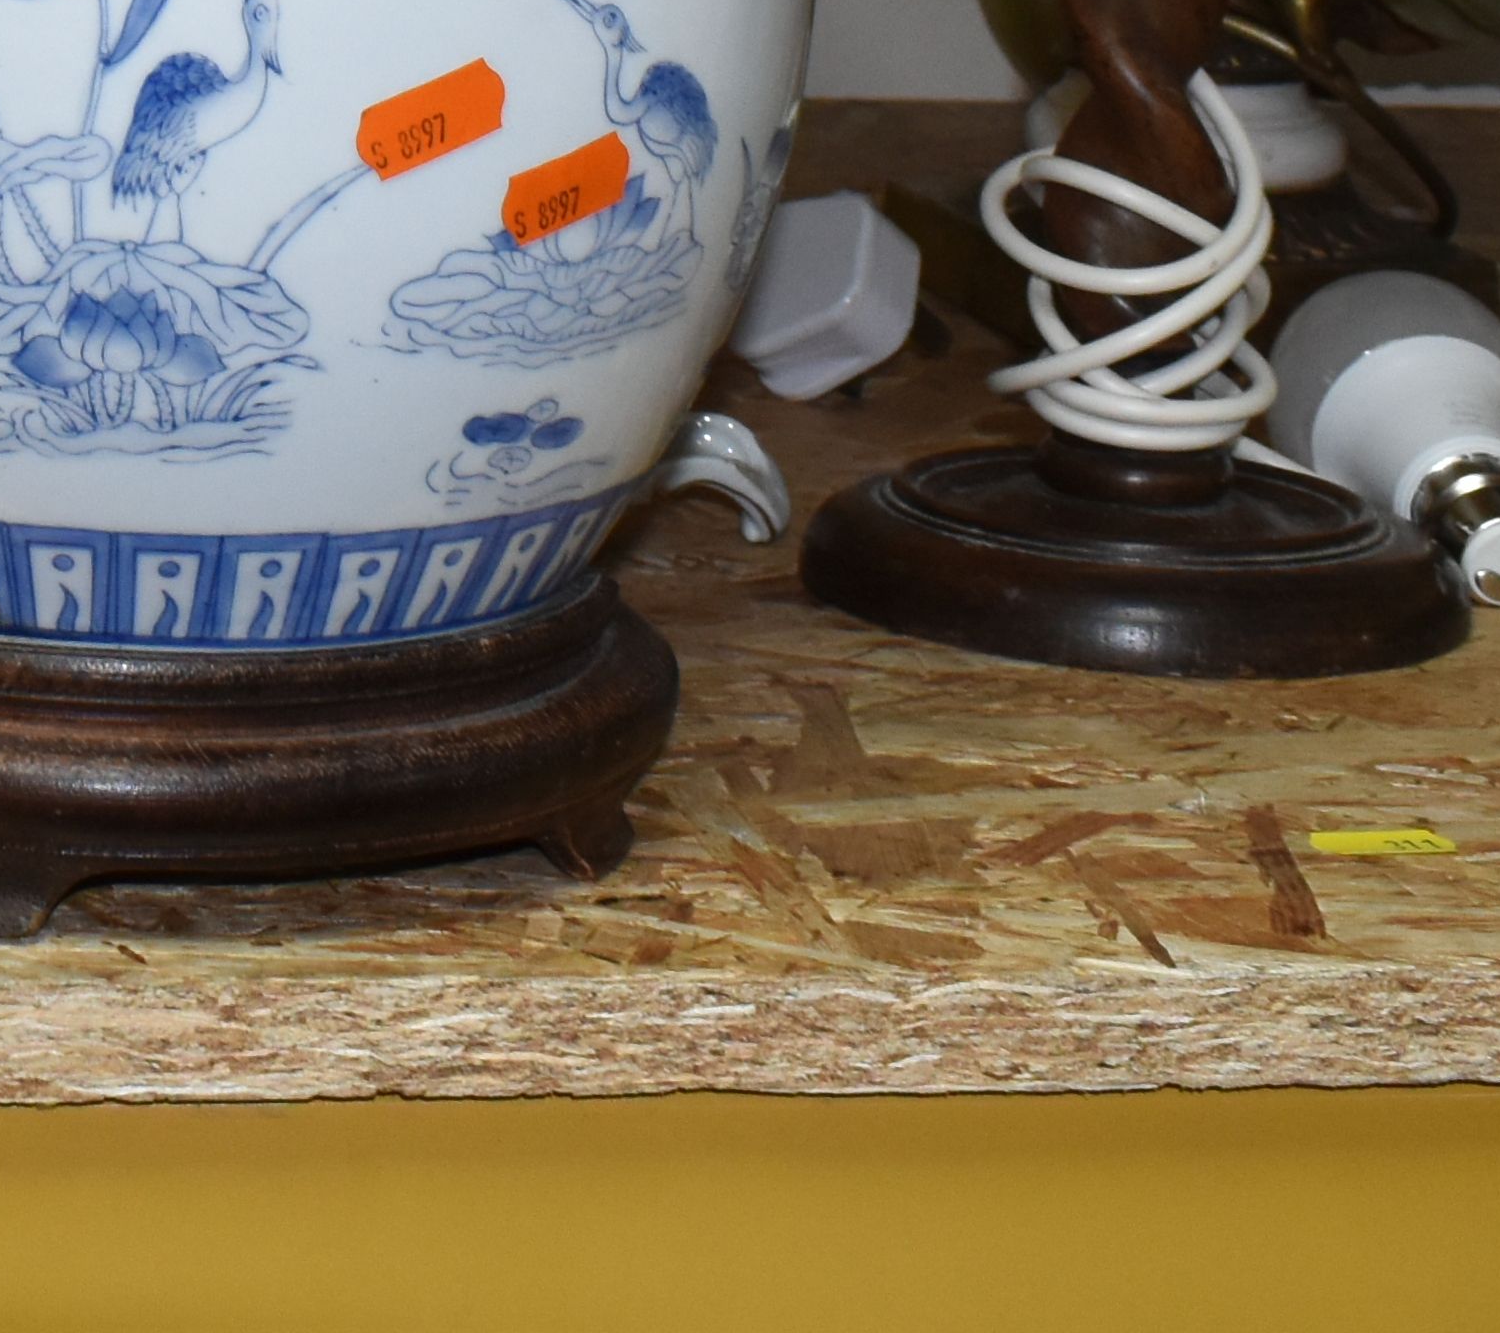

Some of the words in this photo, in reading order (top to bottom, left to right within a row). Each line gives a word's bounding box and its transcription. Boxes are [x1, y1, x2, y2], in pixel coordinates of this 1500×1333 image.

[371, 141, 389, 170] S
[513, 210, 528, 239] S
[537, 186, 581, 231] 8997
